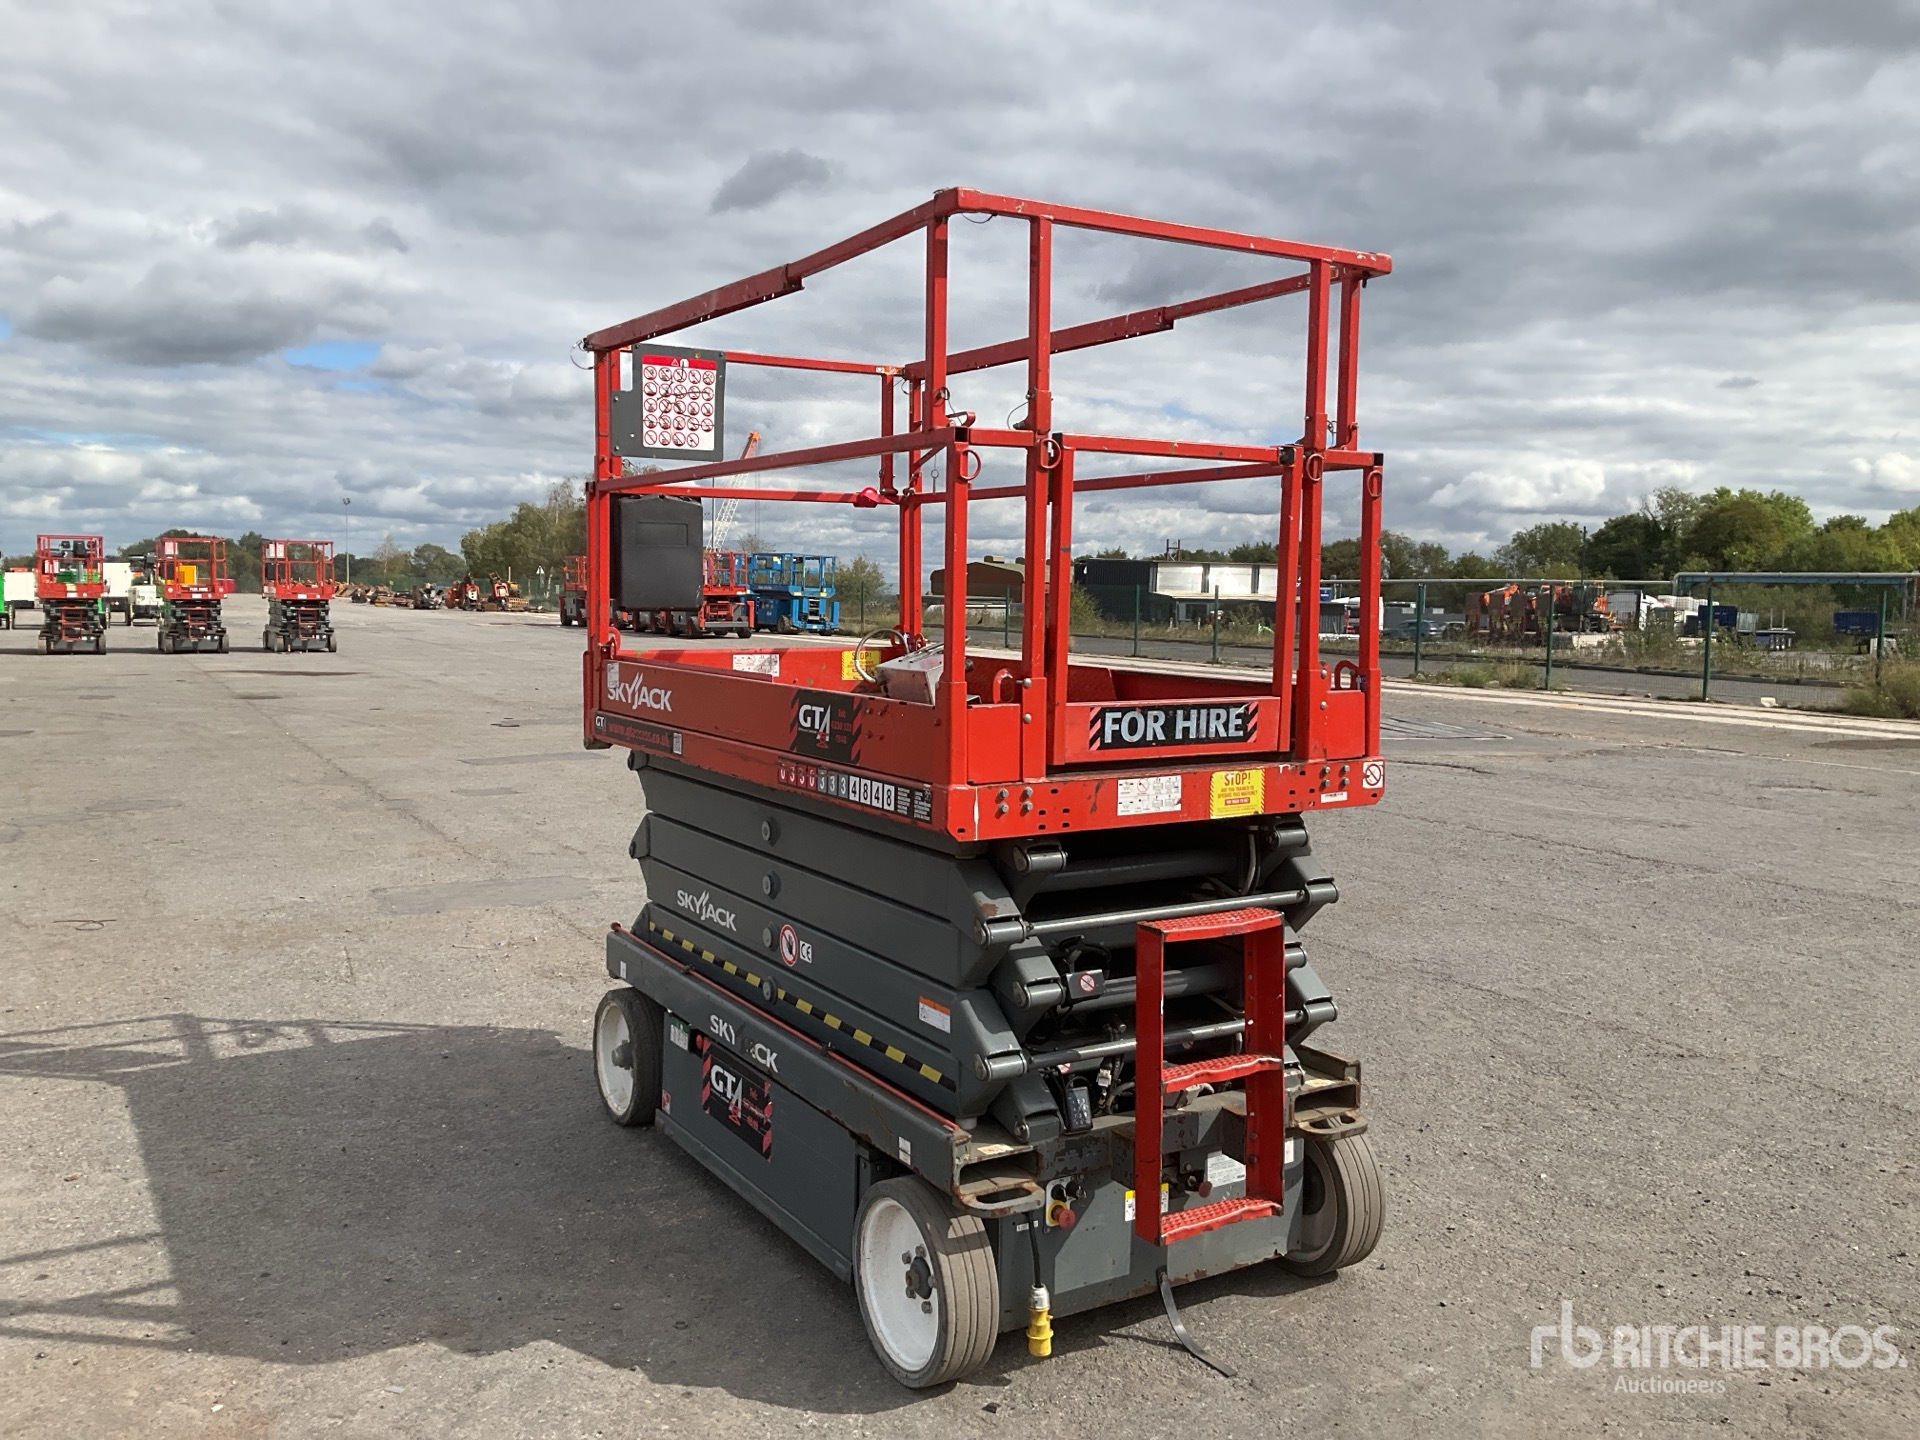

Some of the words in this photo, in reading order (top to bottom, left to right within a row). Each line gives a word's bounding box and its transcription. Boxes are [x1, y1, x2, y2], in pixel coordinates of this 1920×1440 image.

[852, 652, 872, 661] SOP!
[607, 672, 672, 712] SKYJACK
[1104, 711, 1166, 744] FOR
[1175, 706, 1247, 740] HIRE
[1224, 772, 1251, 786] STOP!
[676, 890, 737, 932] SKYJACK
[710, 1014, 779, 1073] SKYCK
